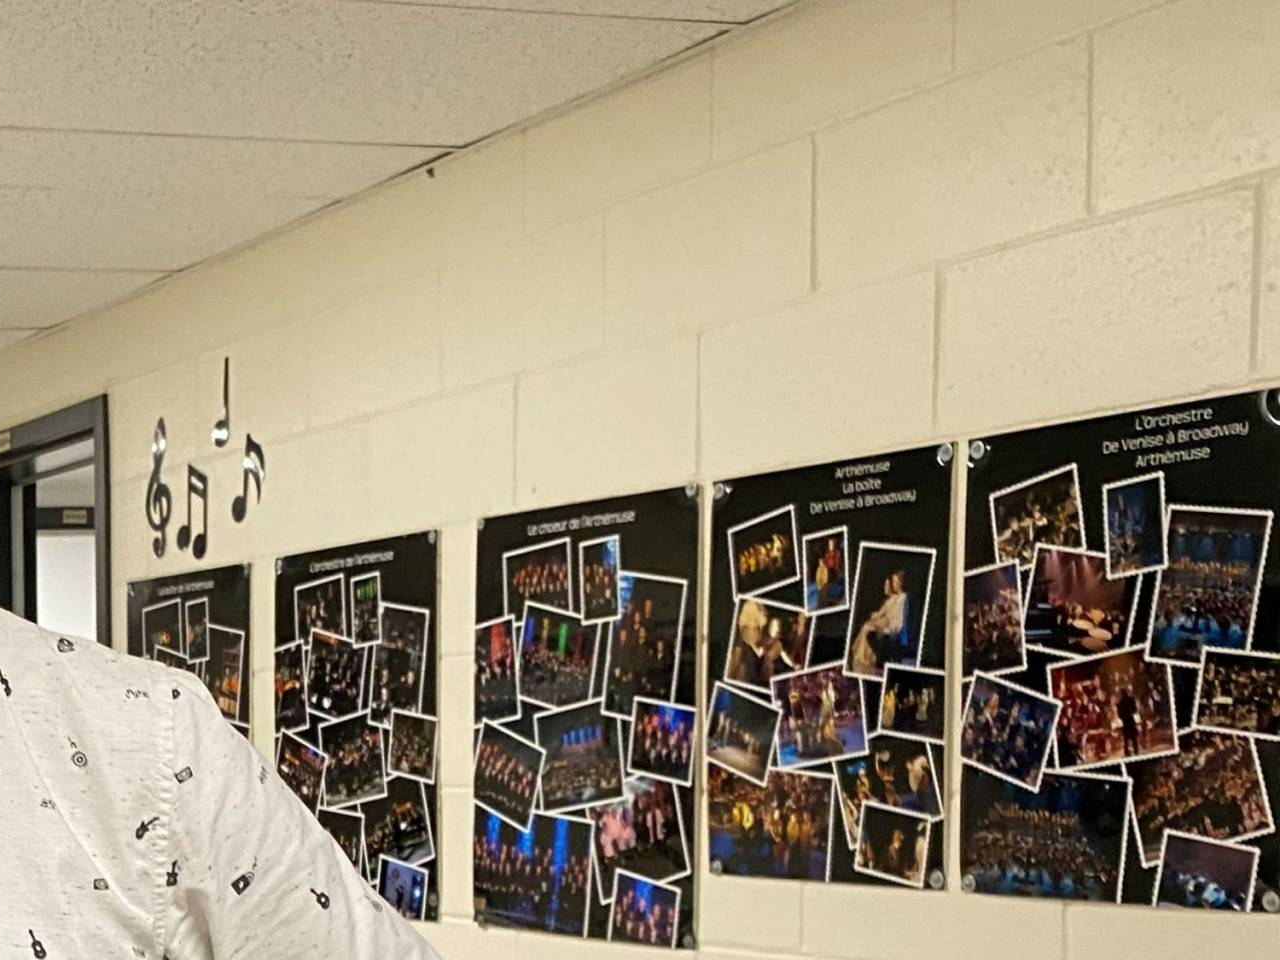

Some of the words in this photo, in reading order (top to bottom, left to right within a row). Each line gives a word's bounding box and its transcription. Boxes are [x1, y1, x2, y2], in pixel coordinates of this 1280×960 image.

[1102, 441, 1119, 454] De
[1121, 434, 1164, 451] Venise
[1166, 431, 1175, 444] à
[1177, 421, 1249, 443] Broadway
[1135, 447, 1211, 468] Arthémuse
[835, 461, 891, 479] Arthémuse
[842, 483, 854, 494] La
[809, 502, 822, 515] De
[823, 498, 855, 511] Venise
[864, 489, 917, 507] Broadway
[527, 525, 537, 536] Le
[568, 518, 580, 530] de
